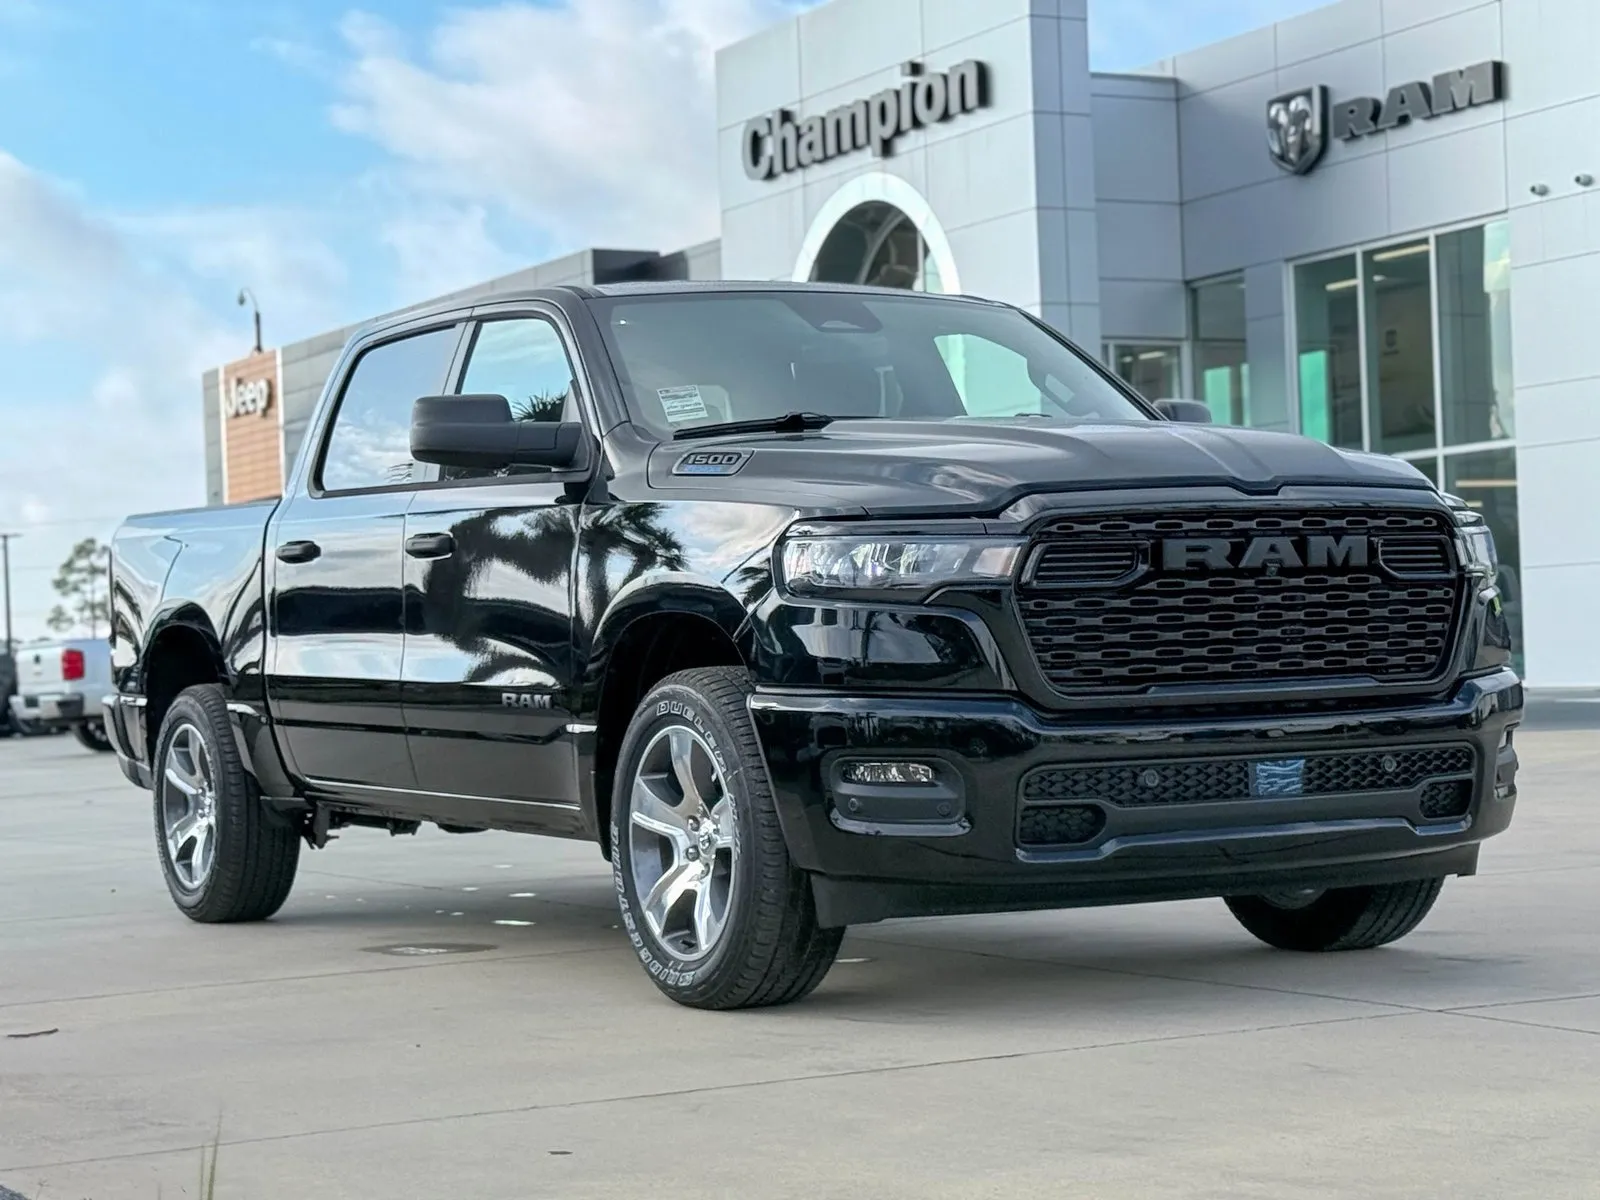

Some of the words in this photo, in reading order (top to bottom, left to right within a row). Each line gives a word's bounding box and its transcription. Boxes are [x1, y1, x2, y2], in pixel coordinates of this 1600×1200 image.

[742, 60, 985, 180] Champion
[1333, 60, 1503, 141] RAM
[225, 378, 269, 418] Jeep
[688, 454, 738, 464] 1500
[1163, 535, 1368, 570] RAM
[501, 692, 552, 709] RAM
[656, 700, 727, 774] DUELER
